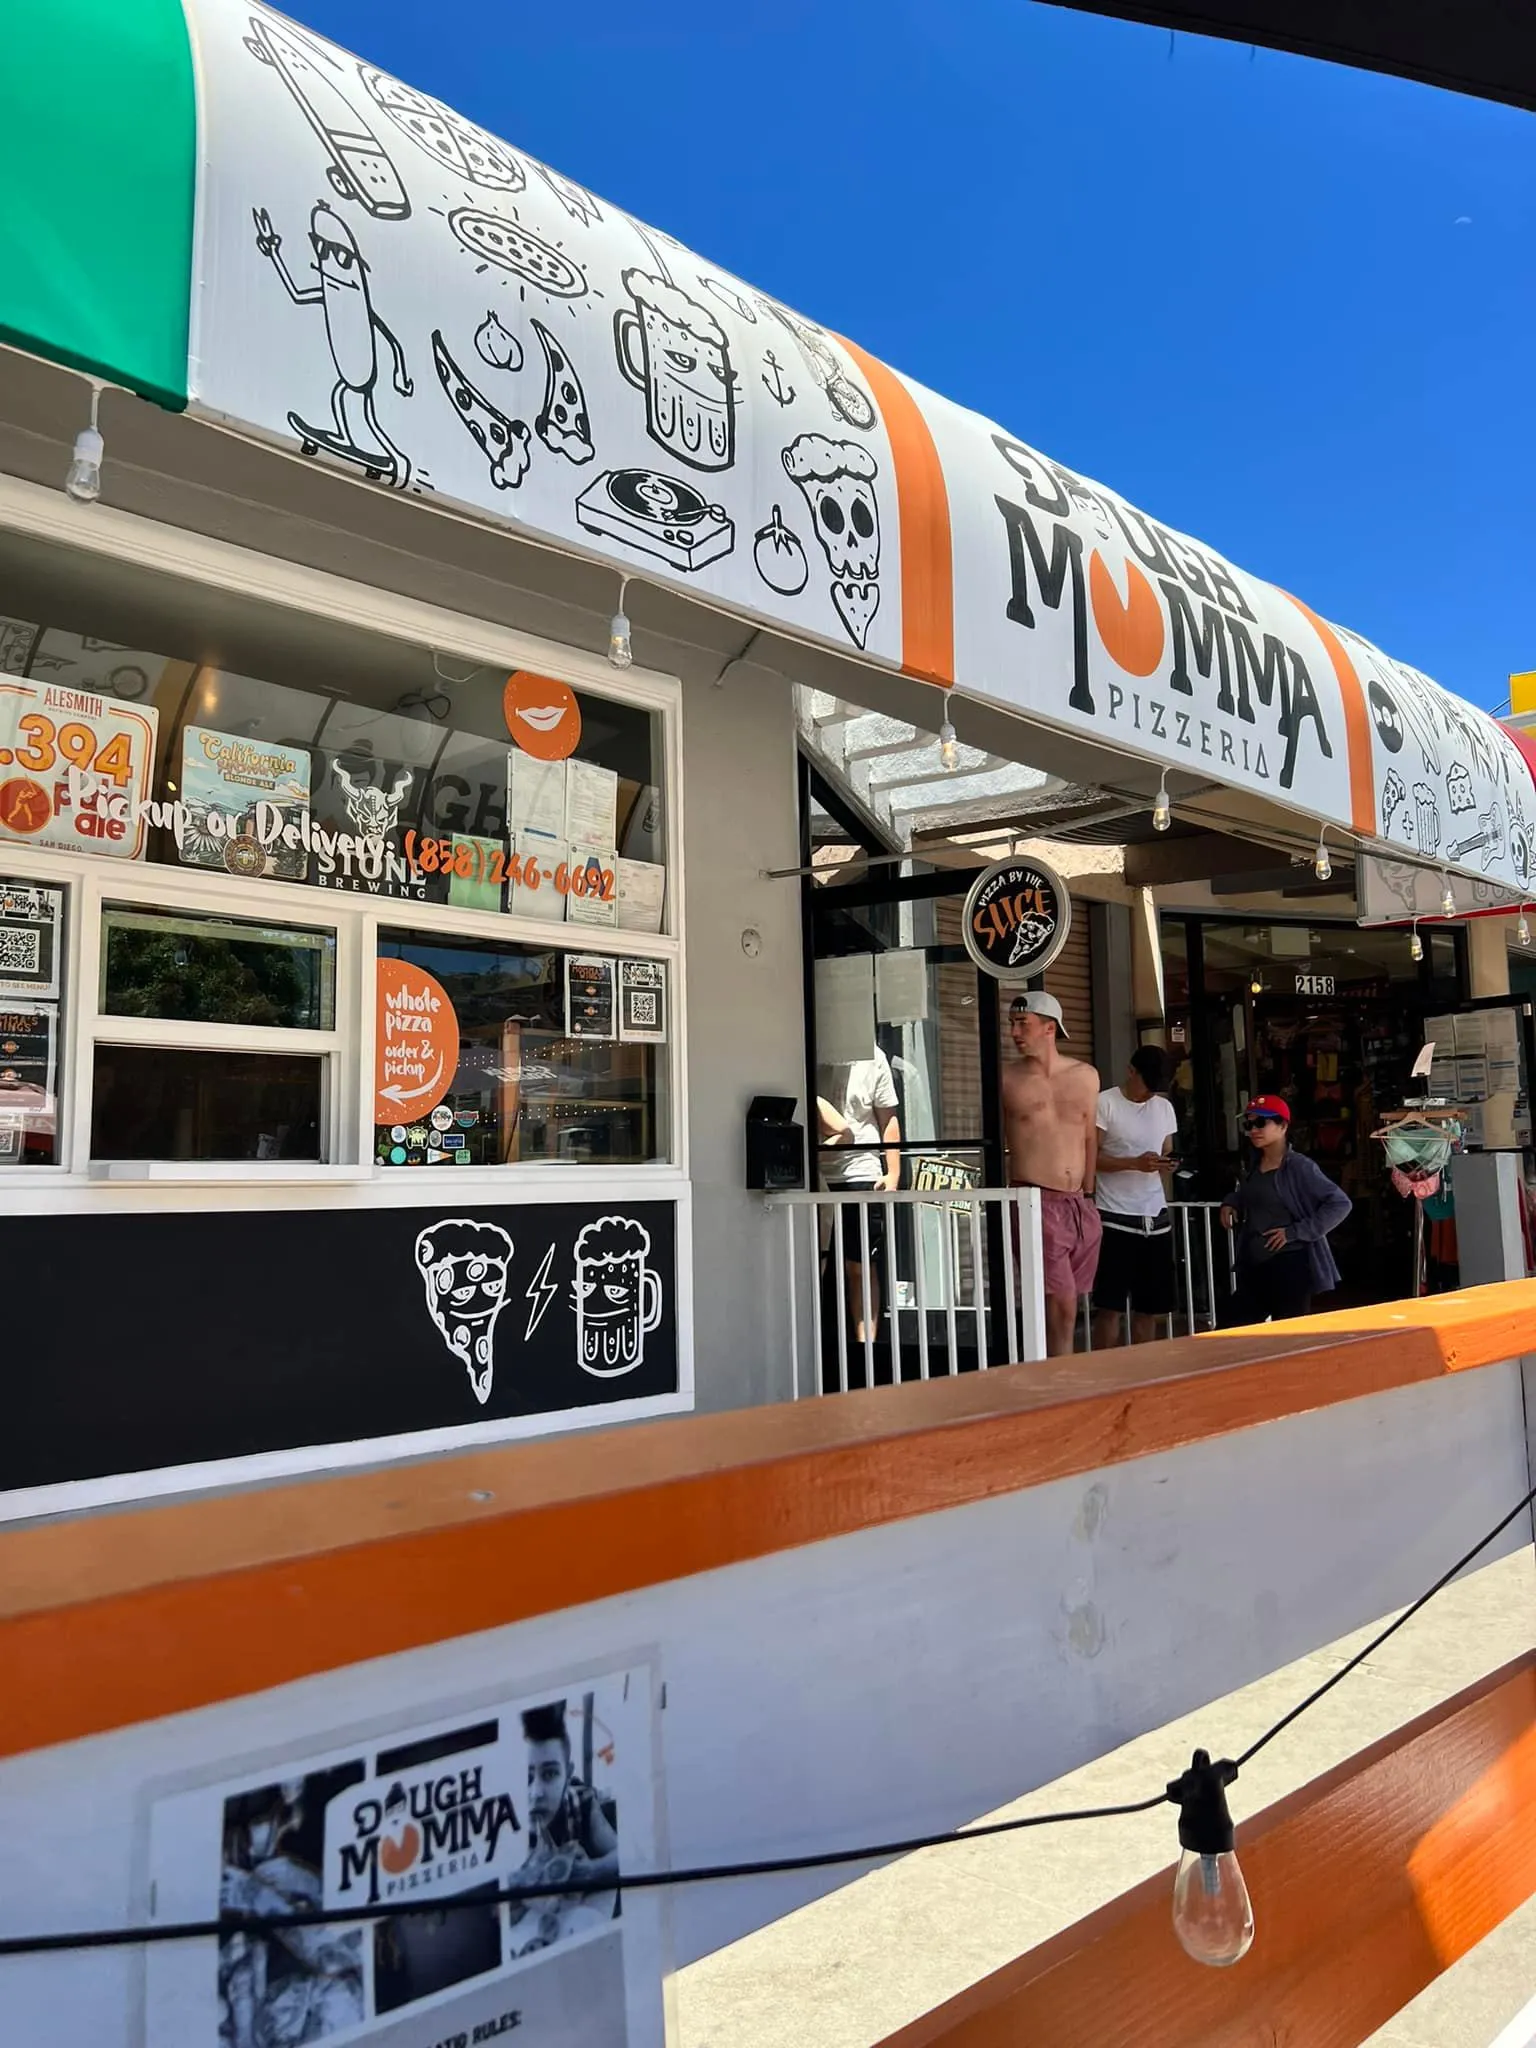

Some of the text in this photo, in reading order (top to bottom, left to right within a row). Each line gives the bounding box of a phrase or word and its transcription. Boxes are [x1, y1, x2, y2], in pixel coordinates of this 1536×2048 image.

[991, 433, 1258, 625] DOUGH
[993, 493, 1333, 789] MOMMA
[44, 687, 103, 718] ALESMITH
[1108, 683, 1270, 779] PIZZERIA
[199, 732, 297, 774] California
[225, 773, 274, 790] BLONDE ALE
[68, 764, 193, 850] Pickup
[206, 811, 242, 840] or
[74, 812, 126, 841] ale
[39, 838, 82, 853] SAN DIEGO
[318, 848, 426, 886] STONE
[318, 874, 426, 899] BREWING
[978, 870, 1044, 907] PIZZA BY THE
[973, 888, 1053, 951] SLICE
[385, 984, 441, 1013] whole
[1296, 976, 1334, 995] 2158
[385, 1011, 432, 1040] pizza
[385, 1040, 435, 1060] order &
[385, 1058, 426, 1083] pickup
[353, 1766, 483, 1839] DOUGH
[338, 1792, 521, 1905] MOMMA
[387, 1852, 479, 1896] PIZZERIA
[472, 2009, 523, 2045] RULES:
